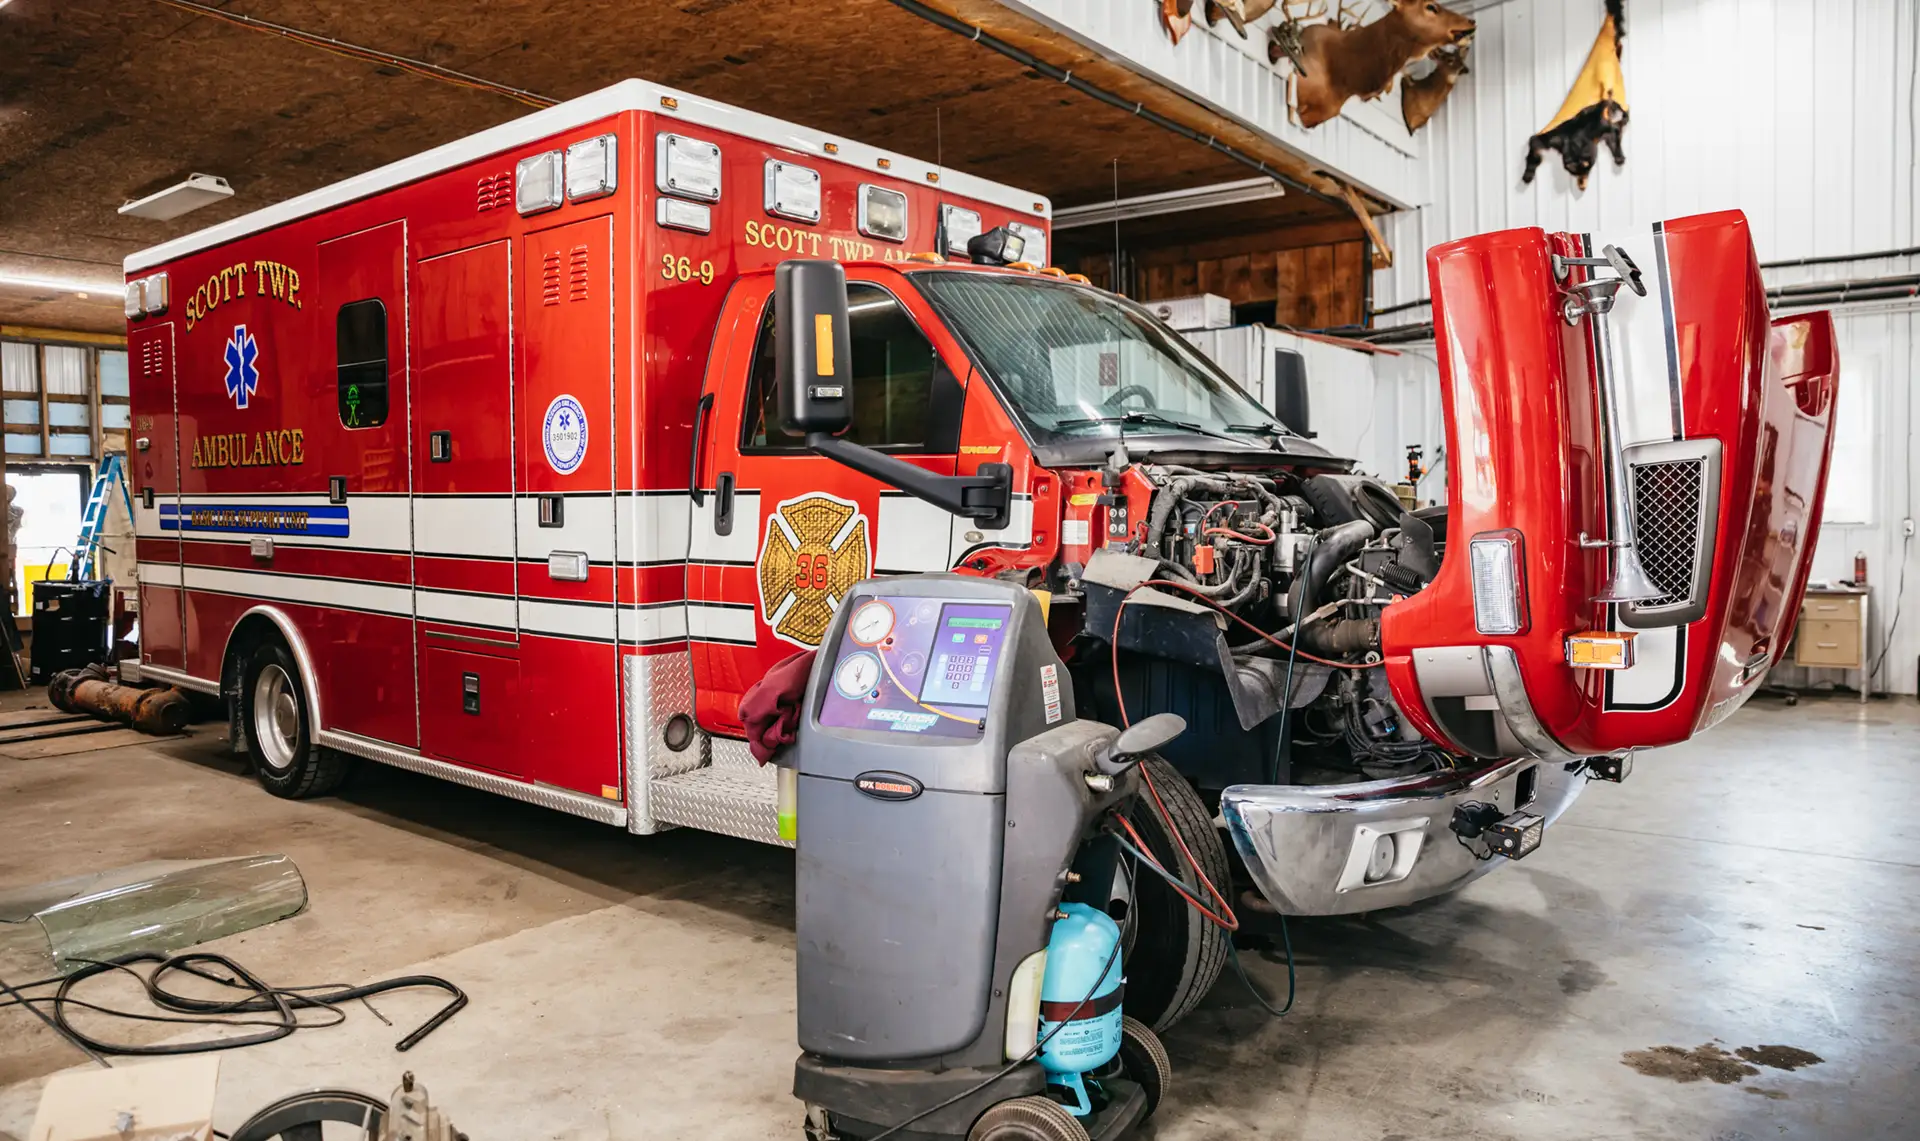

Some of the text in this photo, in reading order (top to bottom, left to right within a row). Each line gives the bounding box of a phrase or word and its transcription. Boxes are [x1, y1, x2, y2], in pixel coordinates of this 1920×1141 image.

[744, 219, 822, 258] SCOTT
[661, 252, 715, 286] 36-9
[185, 260, 302, 334] SCOTT TWP.
[191, 428, 305, 468] AMBULANCE
[552, 431, 578, 442] 3501902
[191, 510, 309, 531] BASIC LIFE SUPPORT UNIT
[795, 553, 829, 590] 36
[860, 780, 913, 794] SPX ROBINAIR
